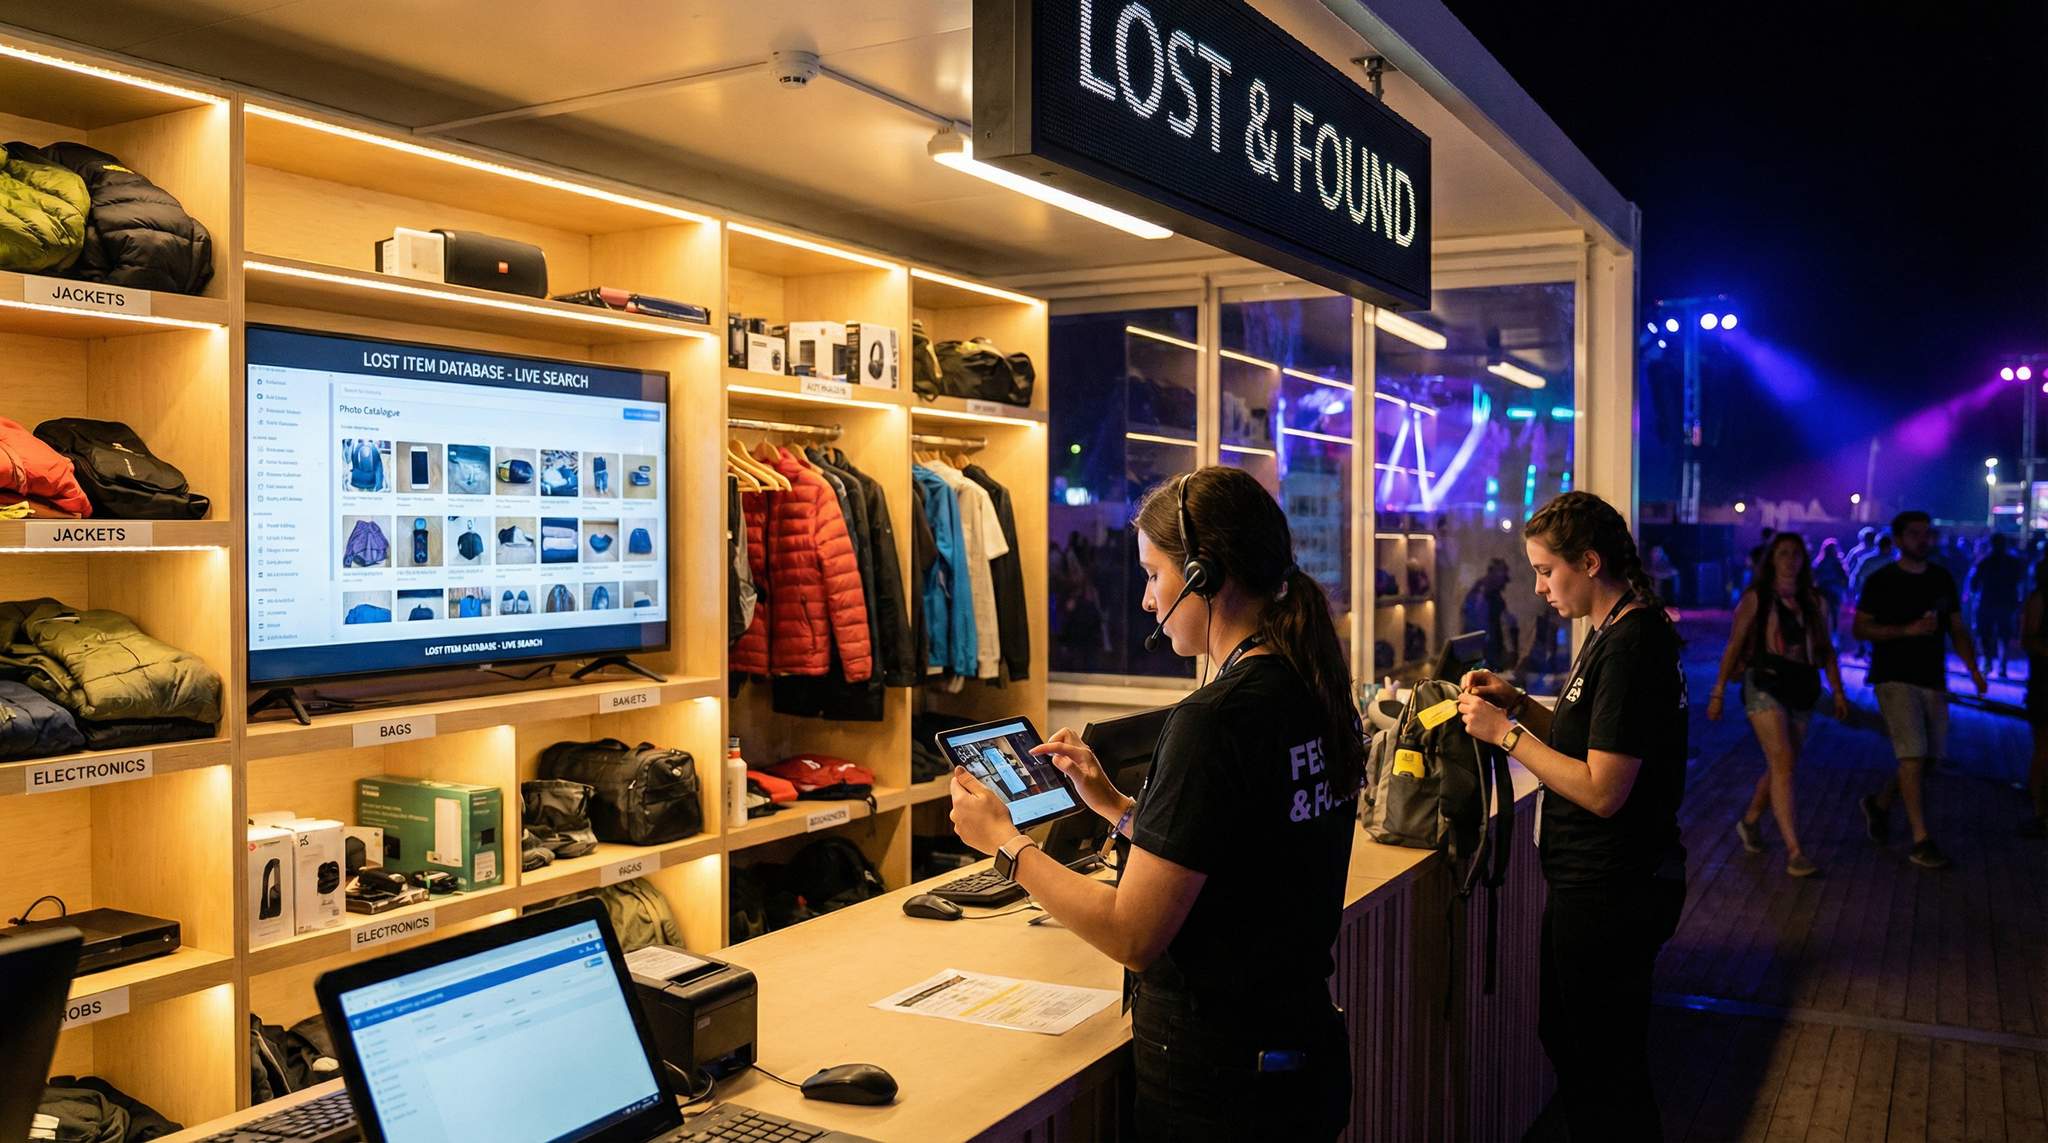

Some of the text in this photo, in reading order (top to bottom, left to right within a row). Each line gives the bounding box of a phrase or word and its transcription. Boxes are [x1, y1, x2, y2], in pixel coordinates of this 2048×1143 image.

[1079, 0, 1417, 248] LOST & FOUND
[52, 286, 125, 306] JACKETS
[363, 351, 400, 369] LOST
[403, 356, 436, 373] ITEM
[439, 358, 505, 380] DATABASE
[515, 367, 541, 384] LIVE
[543, 371, 589, 389] SEARCH
[339, 404, 400, 418] Photo Catalogue
[53, 528, 126, 542] JACKETS
[425, 646, 443, 656] LOST
[379, 723, 412, 738] BAGS
[33, 758, 146, 786] ELECTRONICS
[1290, 789, 1312, 822] &
[357, 917, 430, 944] ELECTRONICS
